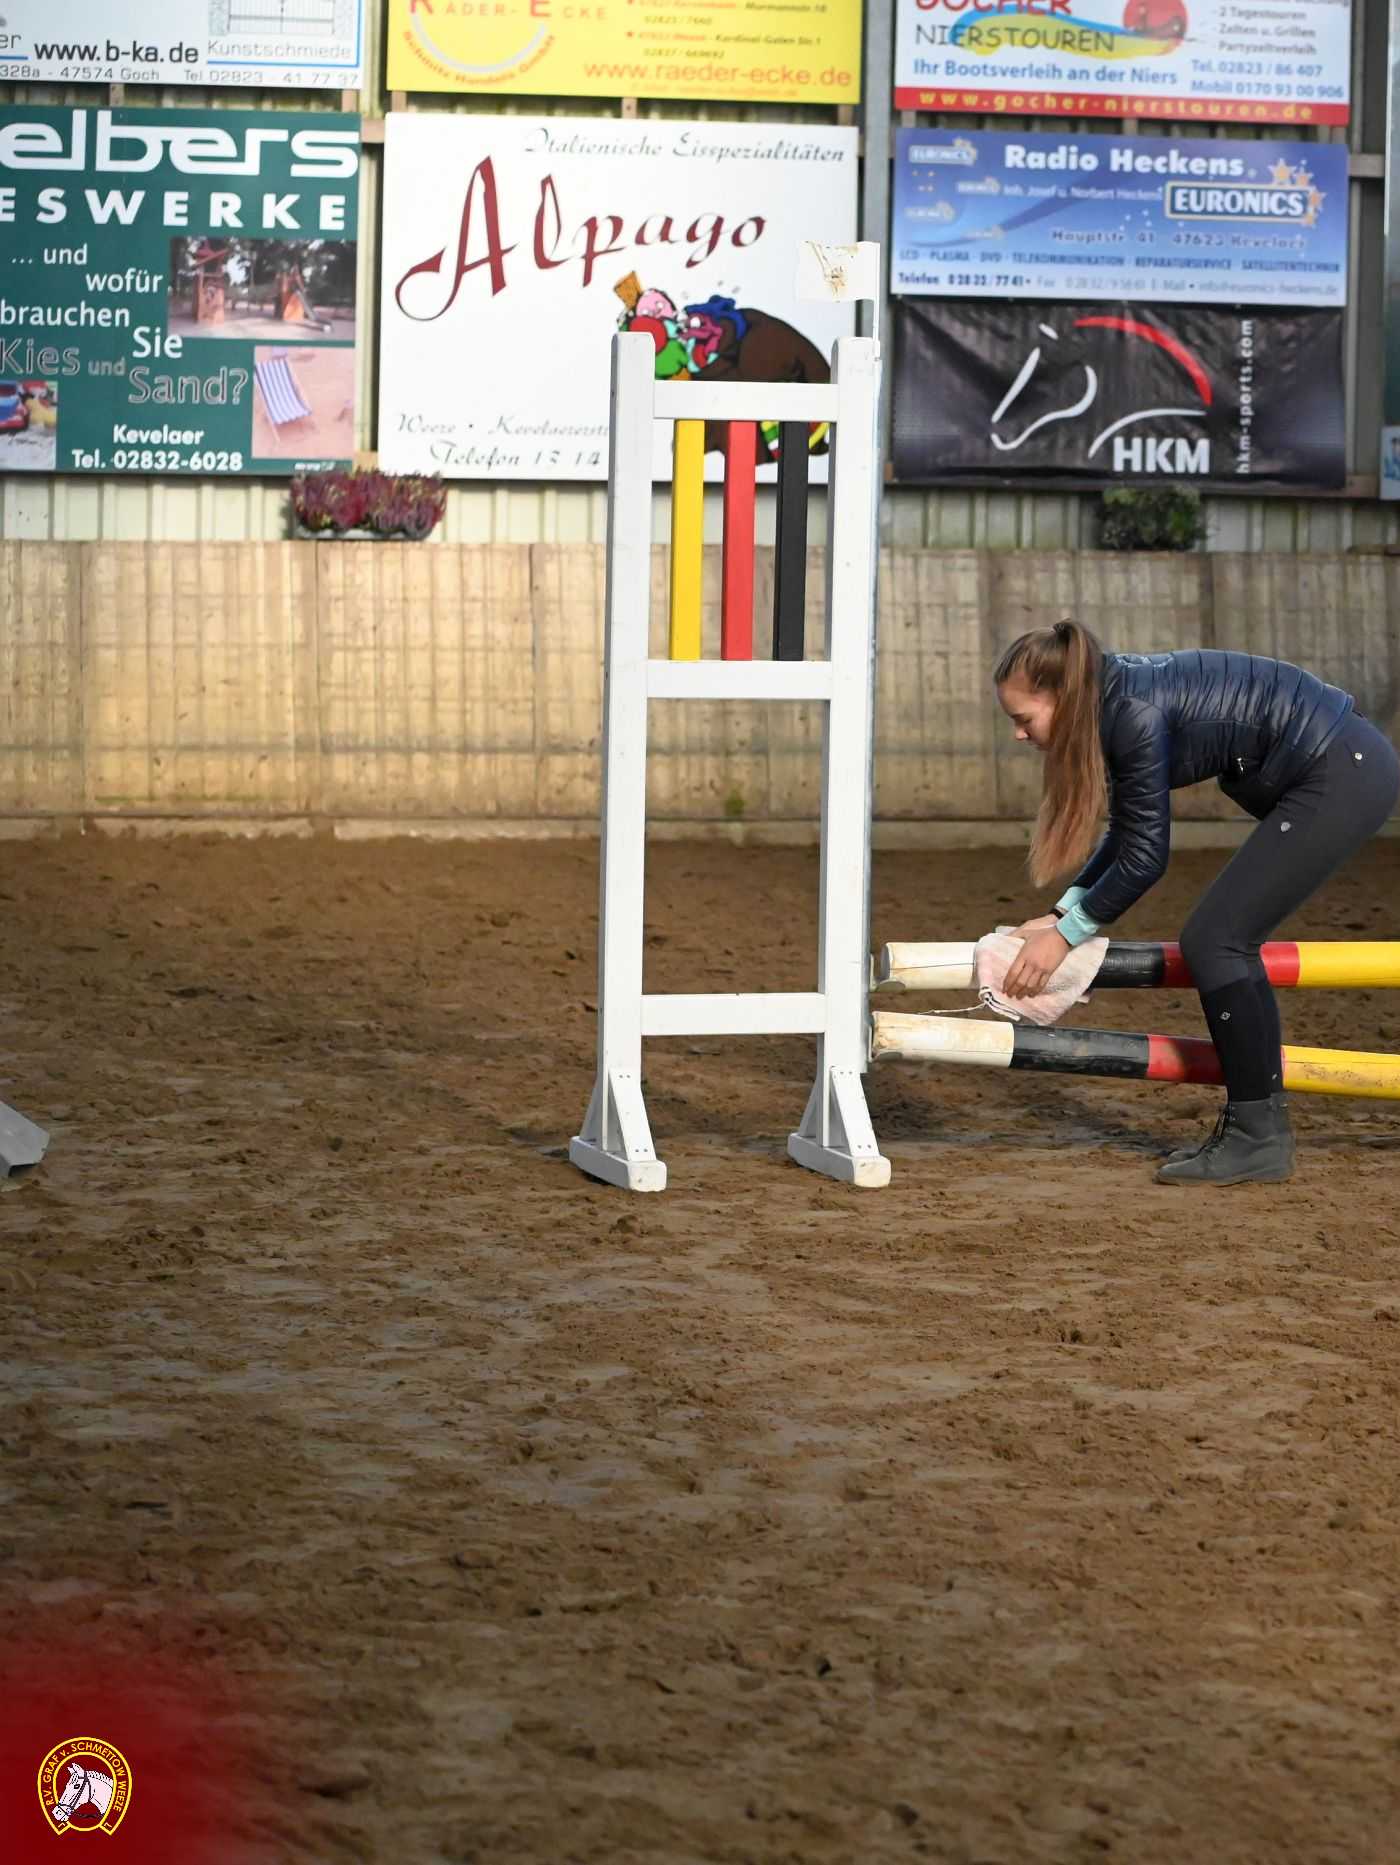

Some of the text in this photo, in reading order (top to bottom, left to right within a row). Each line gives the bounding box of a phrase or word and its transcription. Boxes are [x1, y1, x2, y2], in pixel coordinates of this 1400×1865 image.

[916, 25, 1114, 51] NIERSTOUREN
[1219, 24, 1257, 35] Zelten
[1275, 26, 1317, 38] Grillen
[34, 40, 199, 63] www.b-ka.de
[208, 40, 352, 59] Kunstschmiede
[60, 66, 113, 79] 47574
[120, 69, 160, 81] Goch
[584, 62, 853, 86] www.raeder-ecke.de
[914, 60, 1178, 84] Ihr Bootsverleih an der Niers
[1192, 81, 1233, 93] Mobil
[919, 92, 1313, 120] www.gocher-nierstouren.de
[0, 109, 359, 178] elbers
[672, 132, 845, 163] Eisspezialitäten
[1005, 145, 1244, 176] Radio Heckens
[1174, 190, 1305, 216] EURONICS
[395, 155, 766, 321] Alpago
[43, 244, 87, 265] und
[86, 268, 163, 294] wofür
[0, 302, 131, 326] brauchen
[132, 326, 183, 359] Sie
[0, 337, 248, 405] Kies und Sand?
[1236, 320, 1254, 474] hkm-sports.com
[113, 424, 204, 445] Kevelaer
[72, 449, 243, 472] Tel. 02832-6028
[430, 440, 520, 471] Telefon
[1113, 436, 1210, 473] HKM
